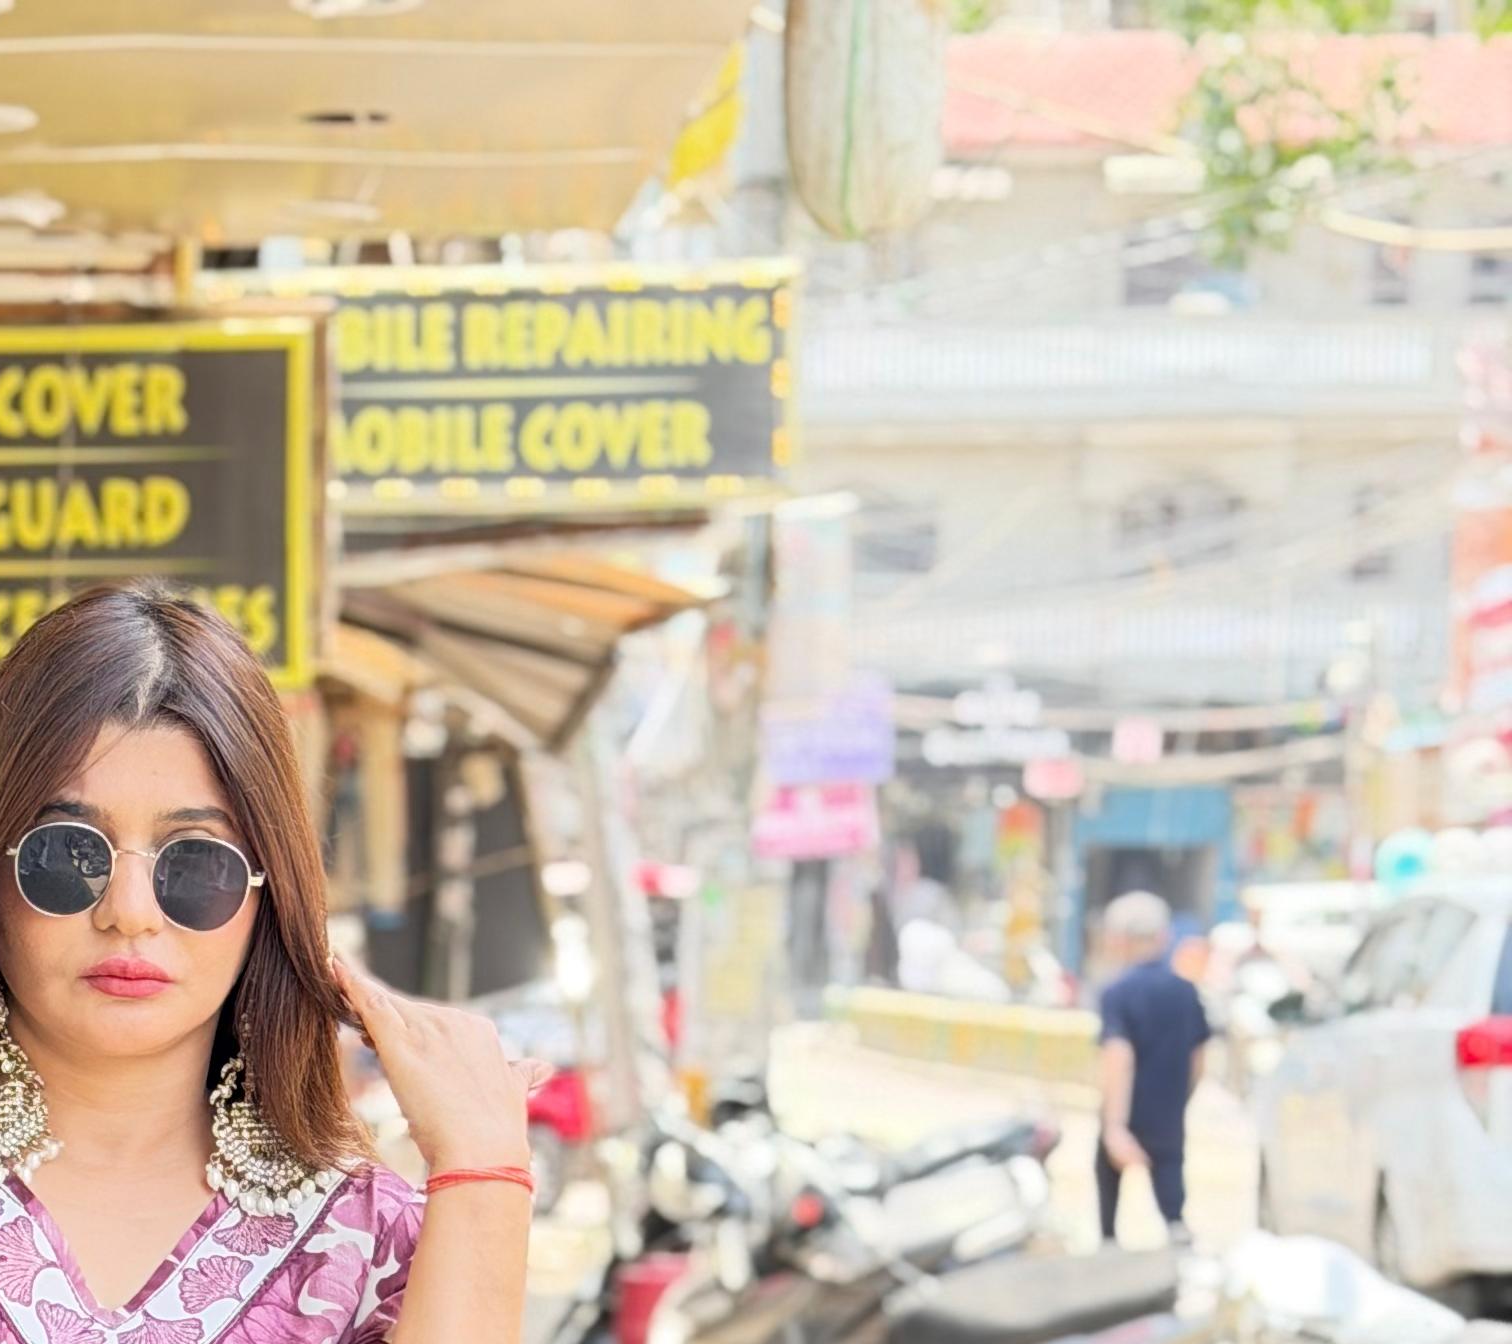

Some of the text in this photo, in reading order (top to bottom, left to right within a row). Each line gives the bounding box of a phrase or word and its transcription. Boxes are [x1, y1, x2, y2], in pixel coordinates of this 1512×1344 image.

[337, 295, 773, 373] BILE REPAIRING
[518, 399, 713, 470] COVER
